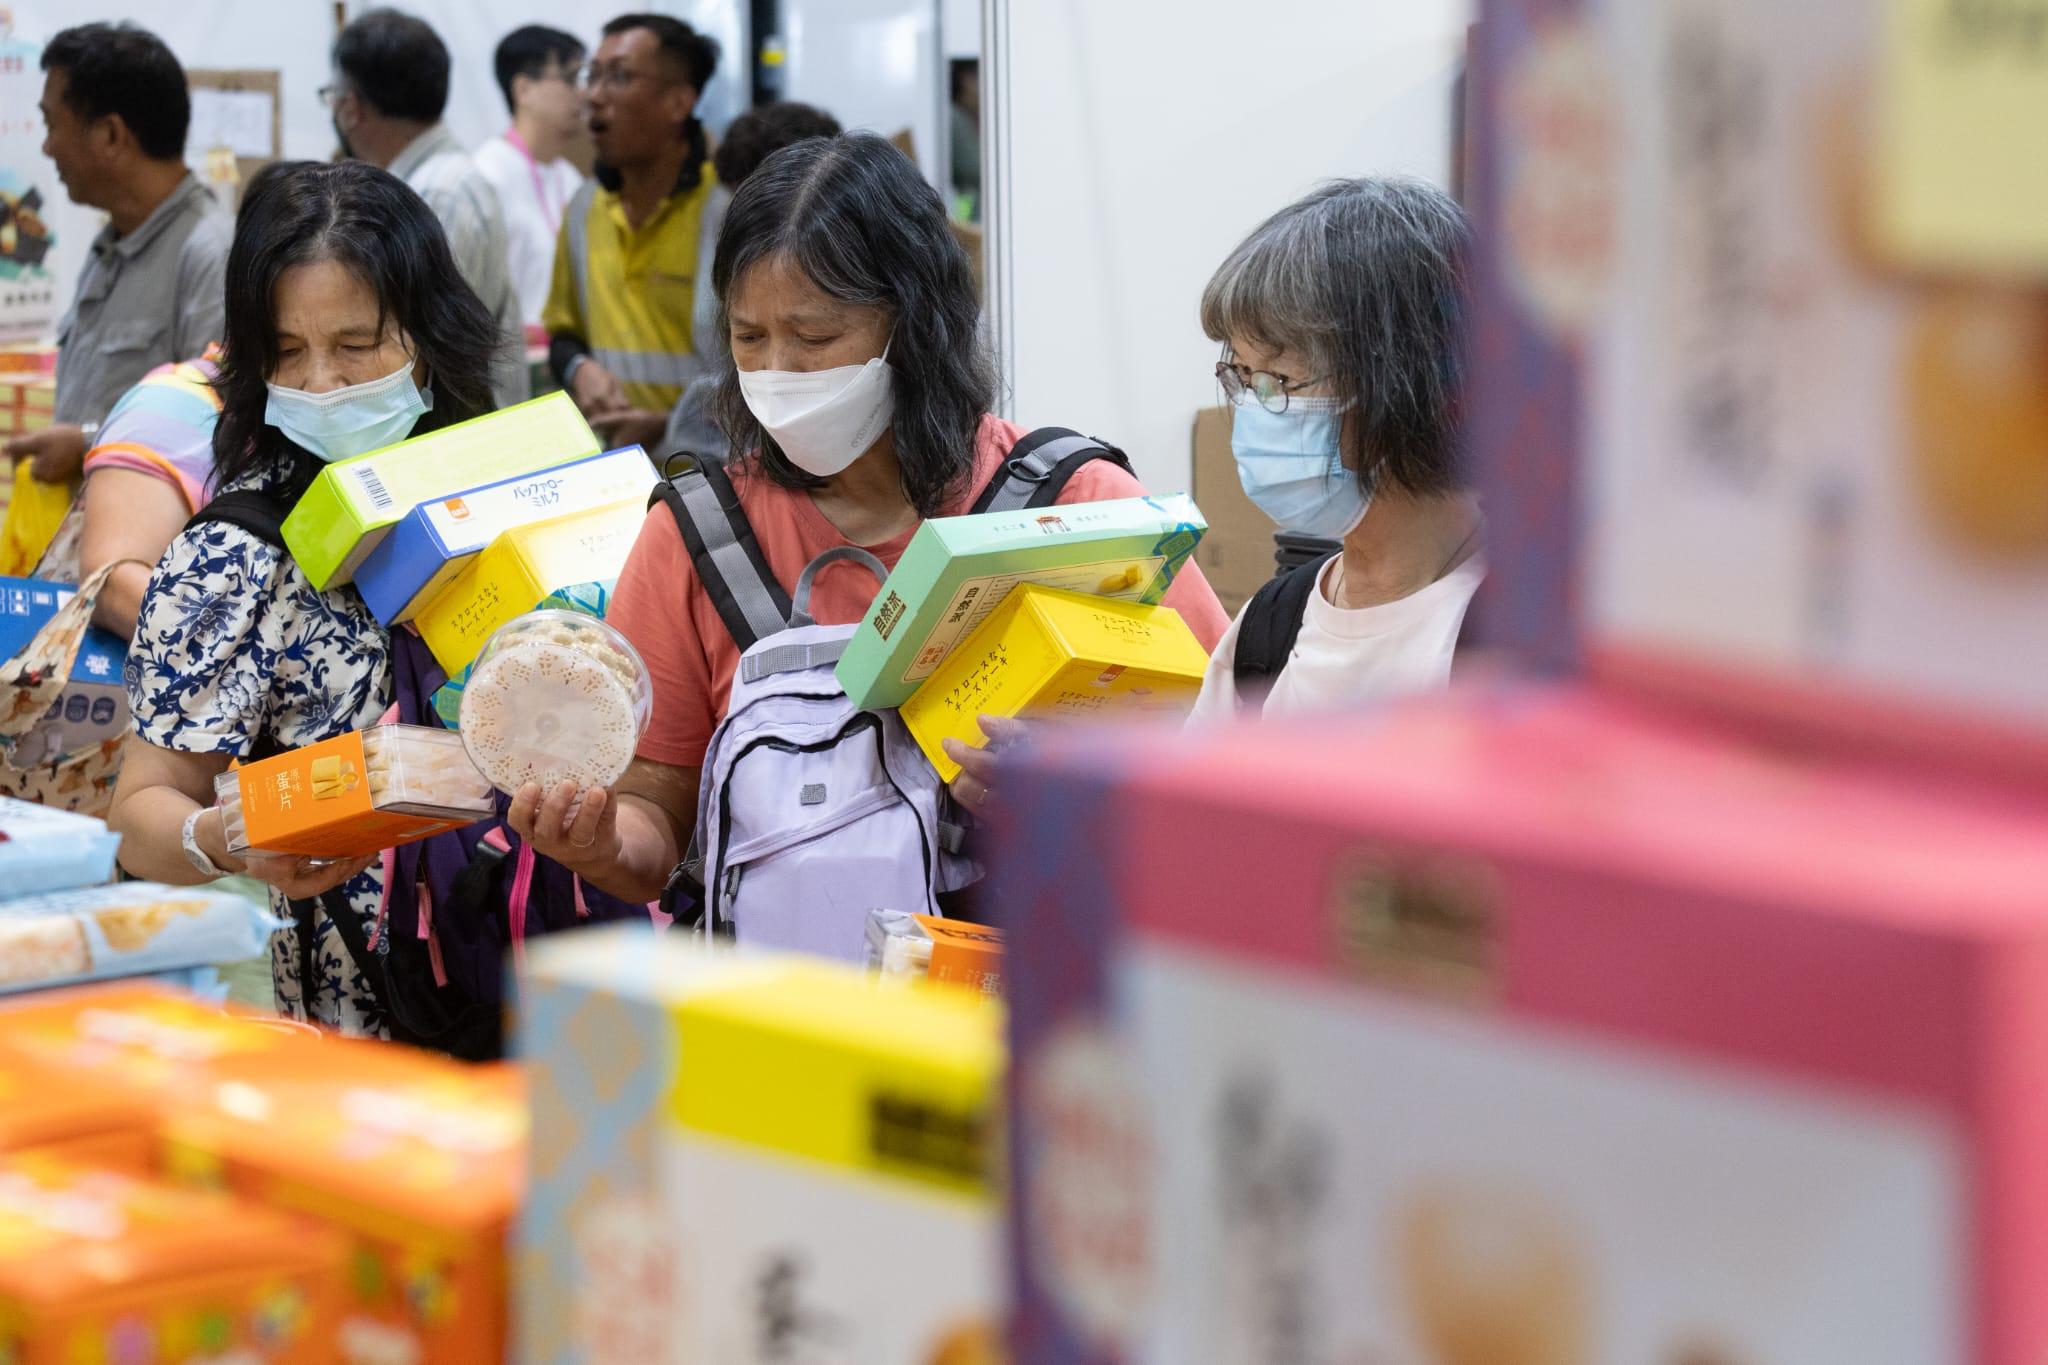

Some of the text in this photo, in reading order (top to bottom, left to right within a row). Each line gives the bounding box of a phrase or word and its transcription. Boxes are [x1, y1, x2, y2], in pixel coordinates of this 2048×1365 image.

[873, 589, 902, 635] 自然派
[945, 642, 1007, 708] スクロースなし
